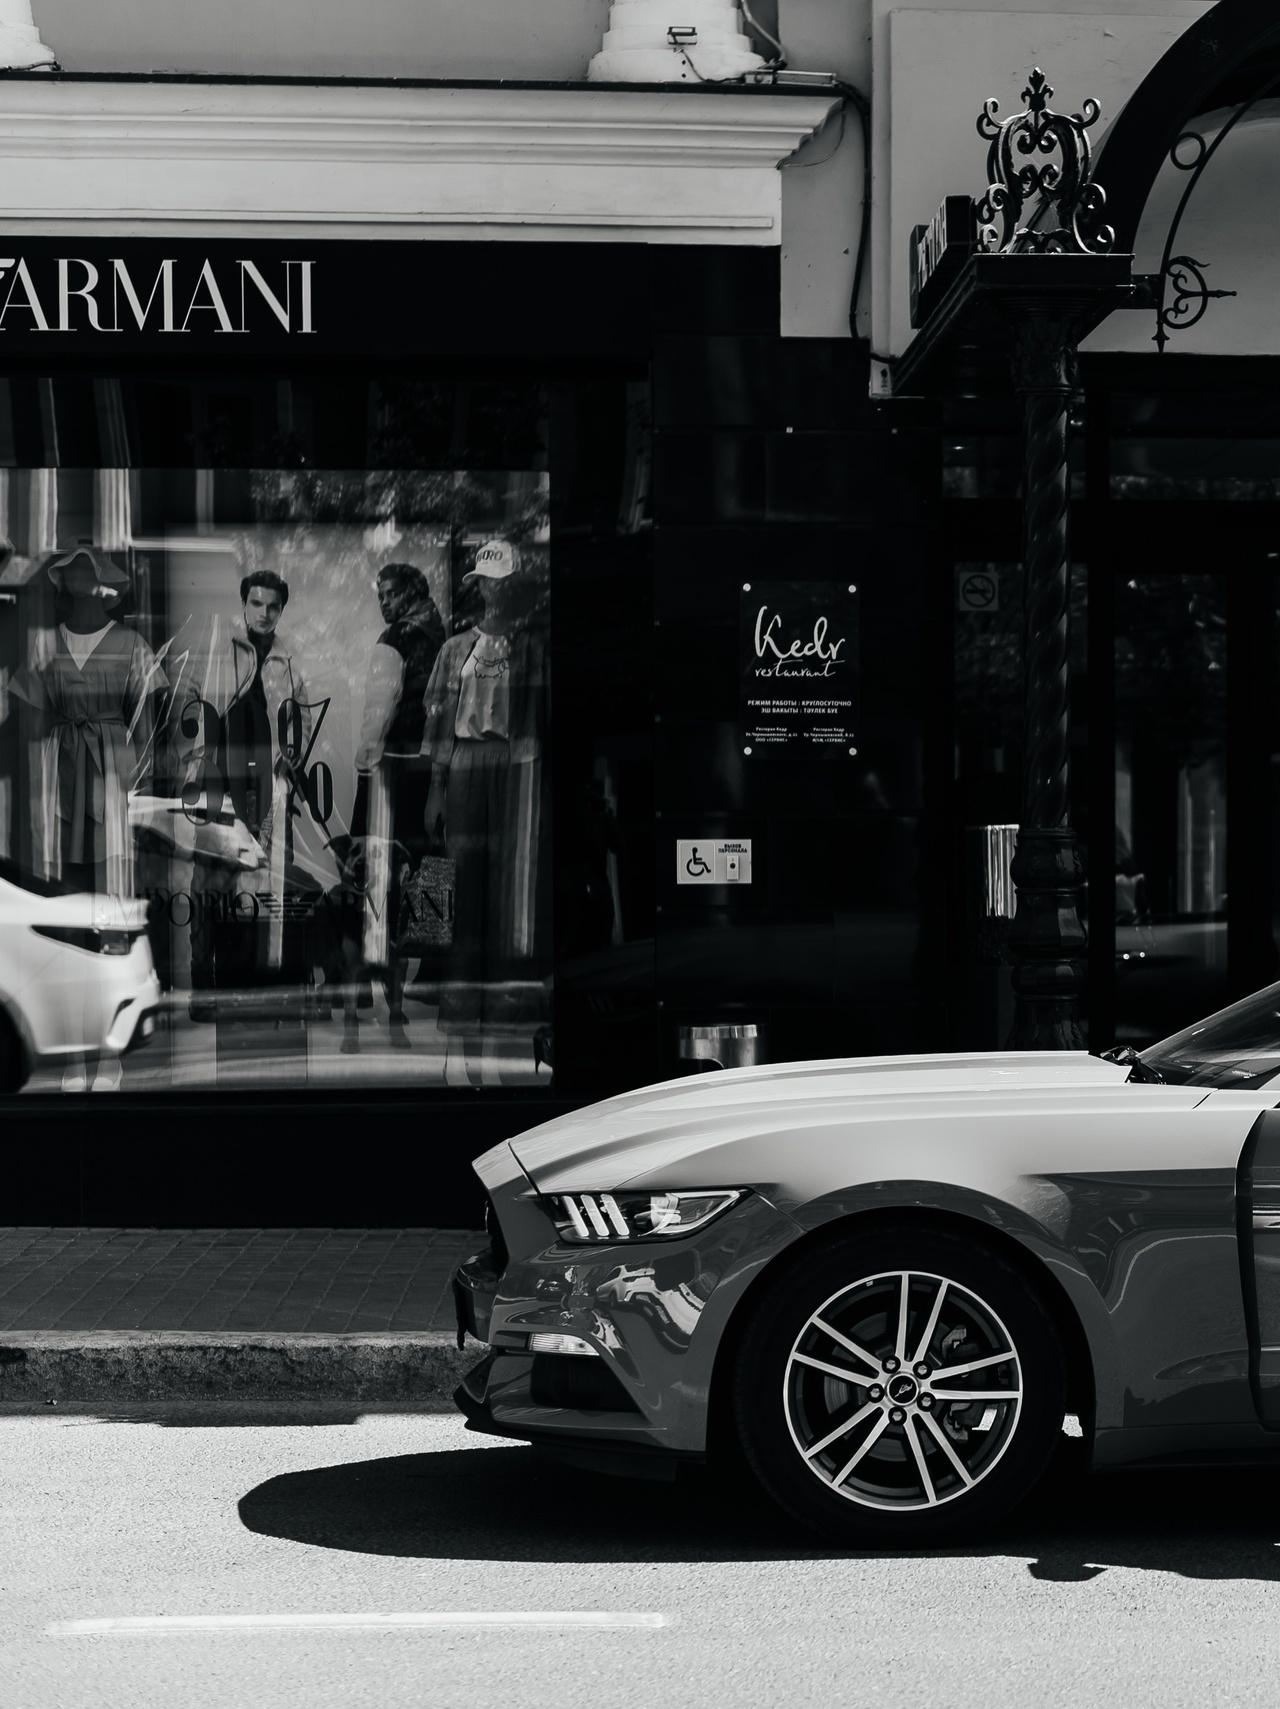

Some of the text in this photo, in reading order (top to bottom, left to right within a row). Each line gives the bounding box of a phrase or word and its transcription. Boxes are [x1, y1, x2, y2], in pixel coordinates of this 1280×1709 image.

[0, 257, 317, 333] ARMANI
[754, 605, 846, 660] Kedr
[755, 658, 846, 678] restaurant
[181, 697, 332, 827] 30%
[90, 889, 454, 928] EMPORIO ARMANI
